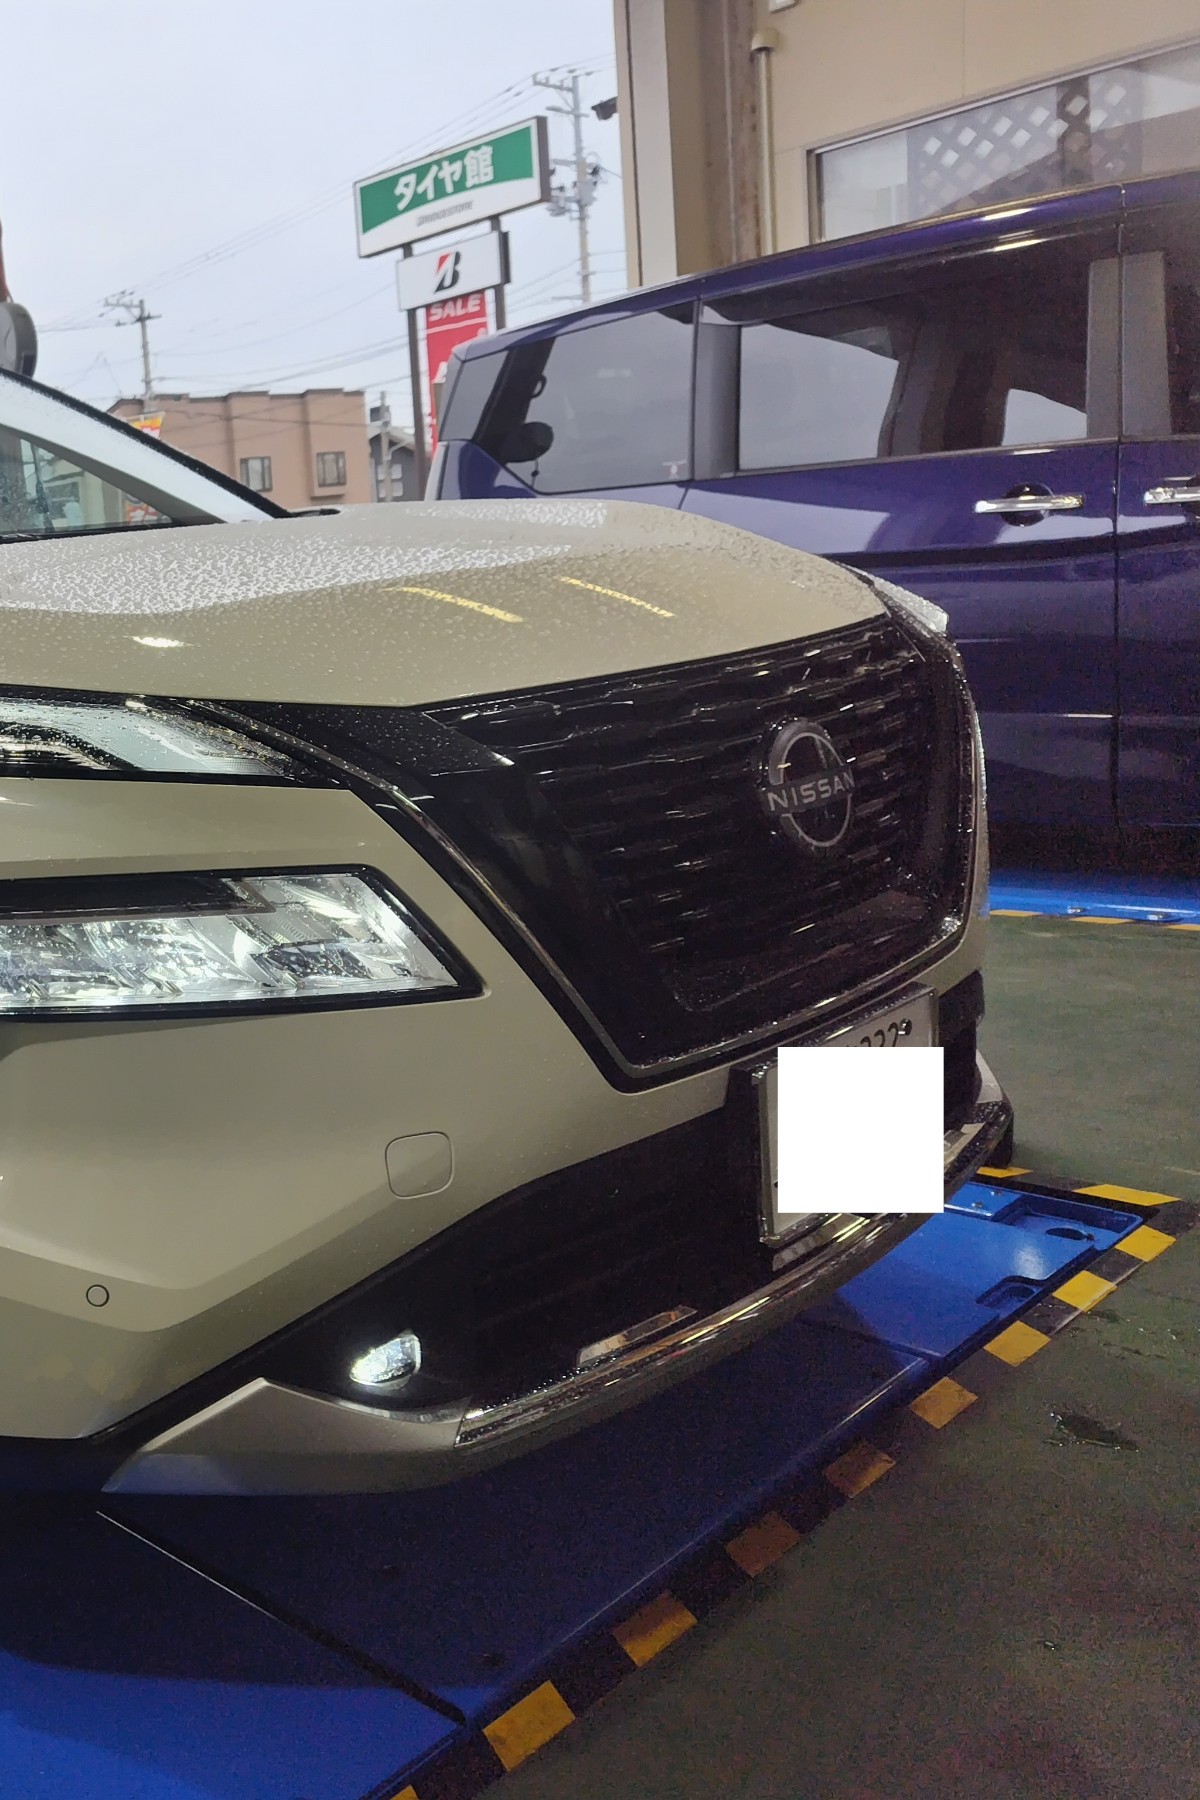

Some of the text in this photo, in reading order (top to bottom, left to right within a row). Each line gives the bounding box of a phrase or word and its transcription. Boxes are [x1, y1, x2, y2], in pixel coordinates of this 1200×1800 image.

[394, 145, 494, 211] タイヤ館
[429, 293, 481, 322] SALE
[767, 767, 855, 811] NISSAN
